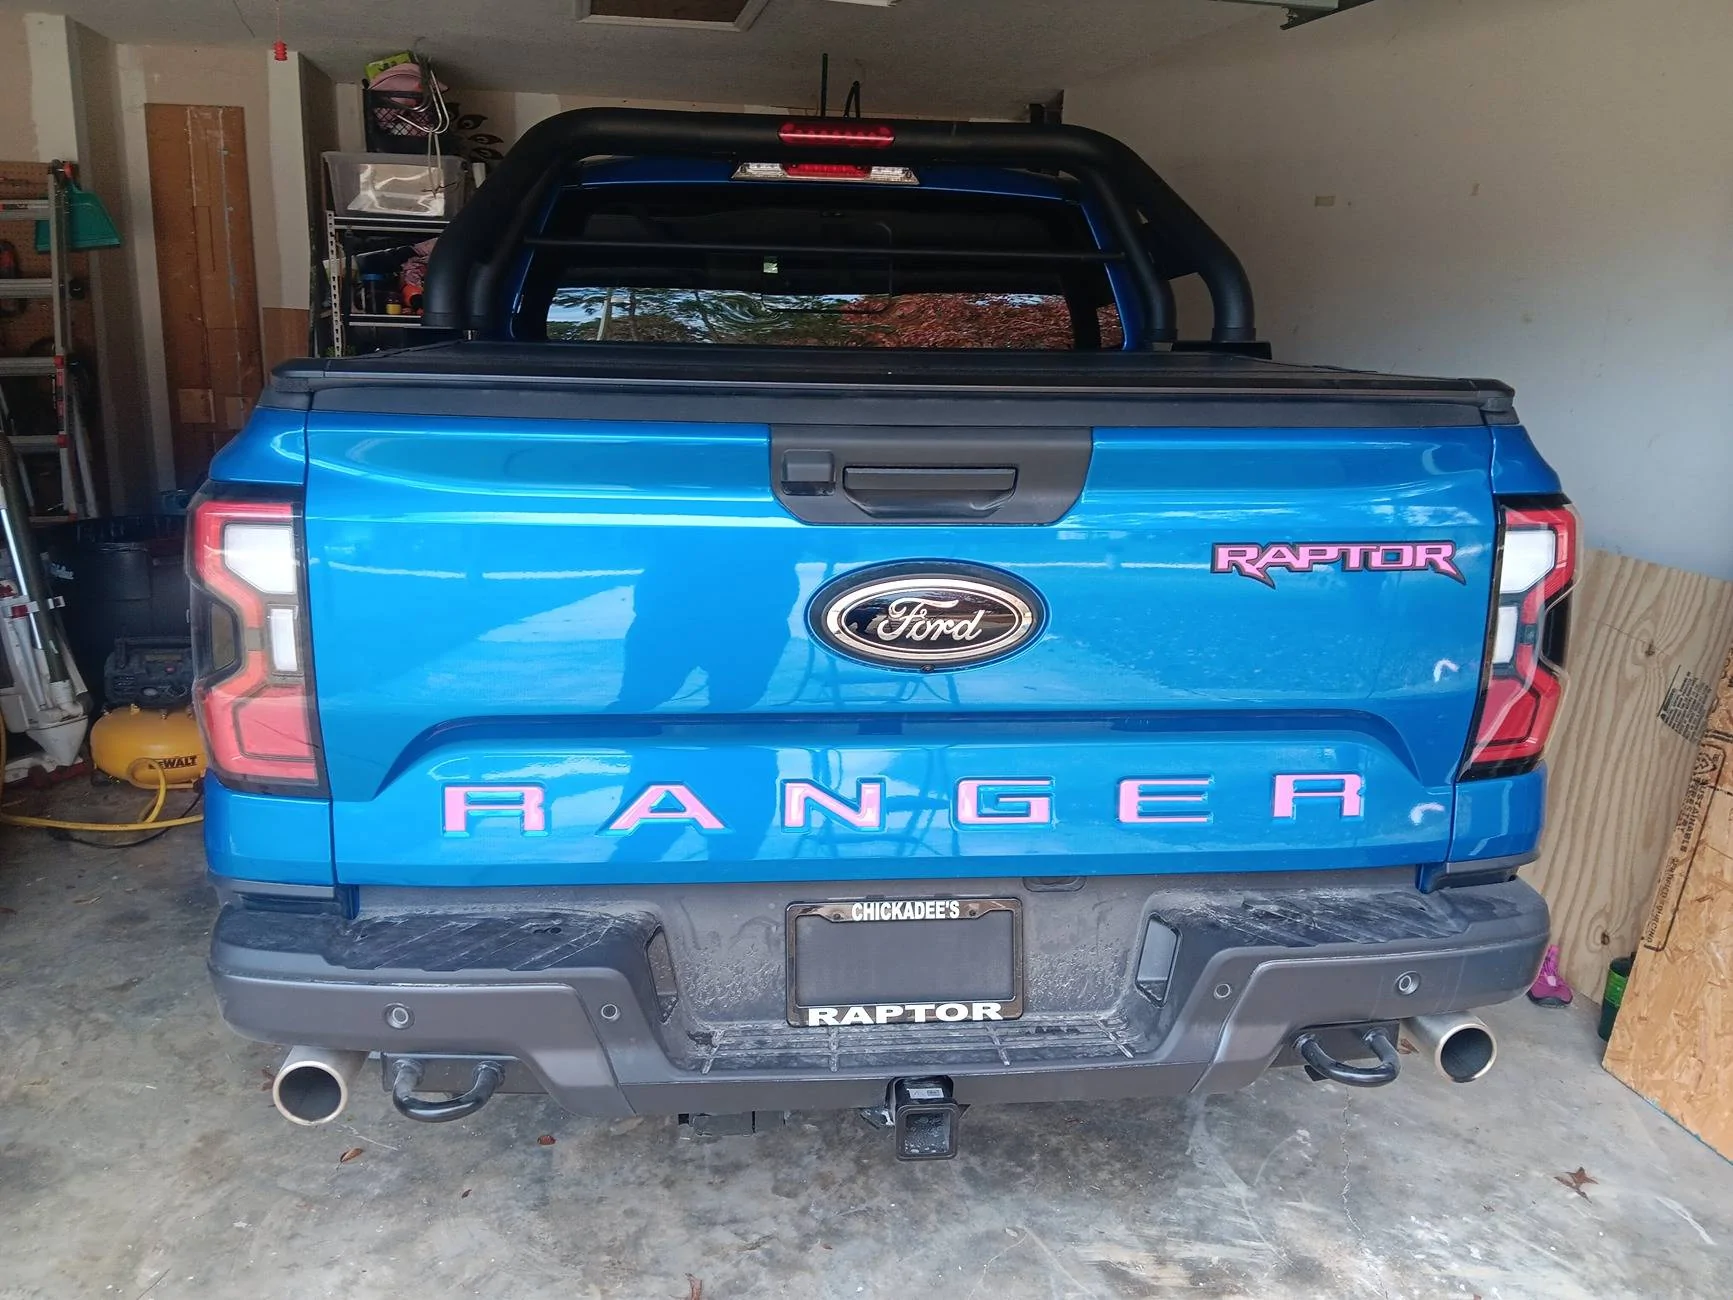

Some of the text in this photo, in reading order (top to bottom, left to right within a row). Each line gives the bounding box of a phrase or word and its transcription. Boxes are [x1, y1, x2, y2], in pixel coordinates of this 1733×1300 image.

[1210, 540, 1467, 589] RAPTOR
[878, 597, 985, 641] Ford
[148, 755, 197, 769] EWALT
[442, 773, 1364, 834] RANGER
[851, 900, 960, 921] CHICKADEE'S
[808, 1002, 1003, 1026] RAPTOR
